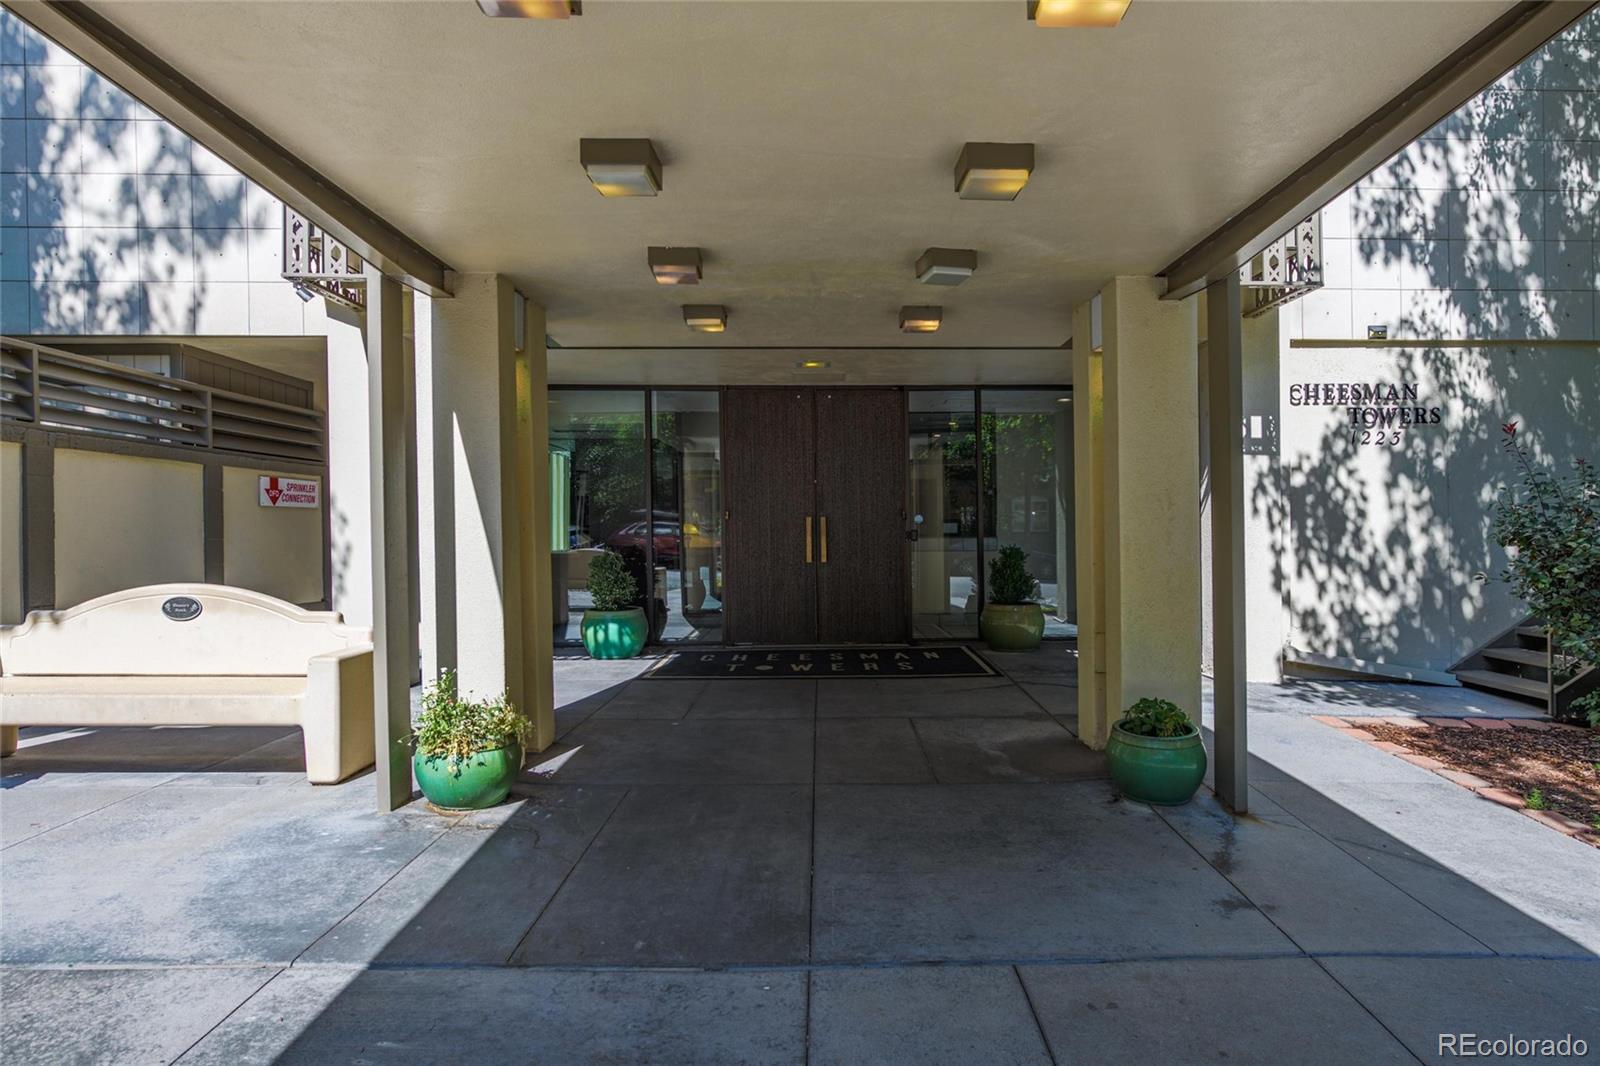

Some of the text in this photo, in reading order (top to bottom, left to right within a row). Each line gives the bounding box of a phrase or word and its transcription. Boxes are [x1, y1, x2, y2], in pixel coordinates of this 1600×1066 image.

[1290, 383, 1419, 401] CHEESMAN
[1347, 407, 1441, 424] TOWERS
[1351, 430, 1401, 445] 1223
[286, 482, 316, 493] SPRINKLER
[281, 493, 316, 504] CONNECTION
[699, 651, 940, 662] CHEESMAN
